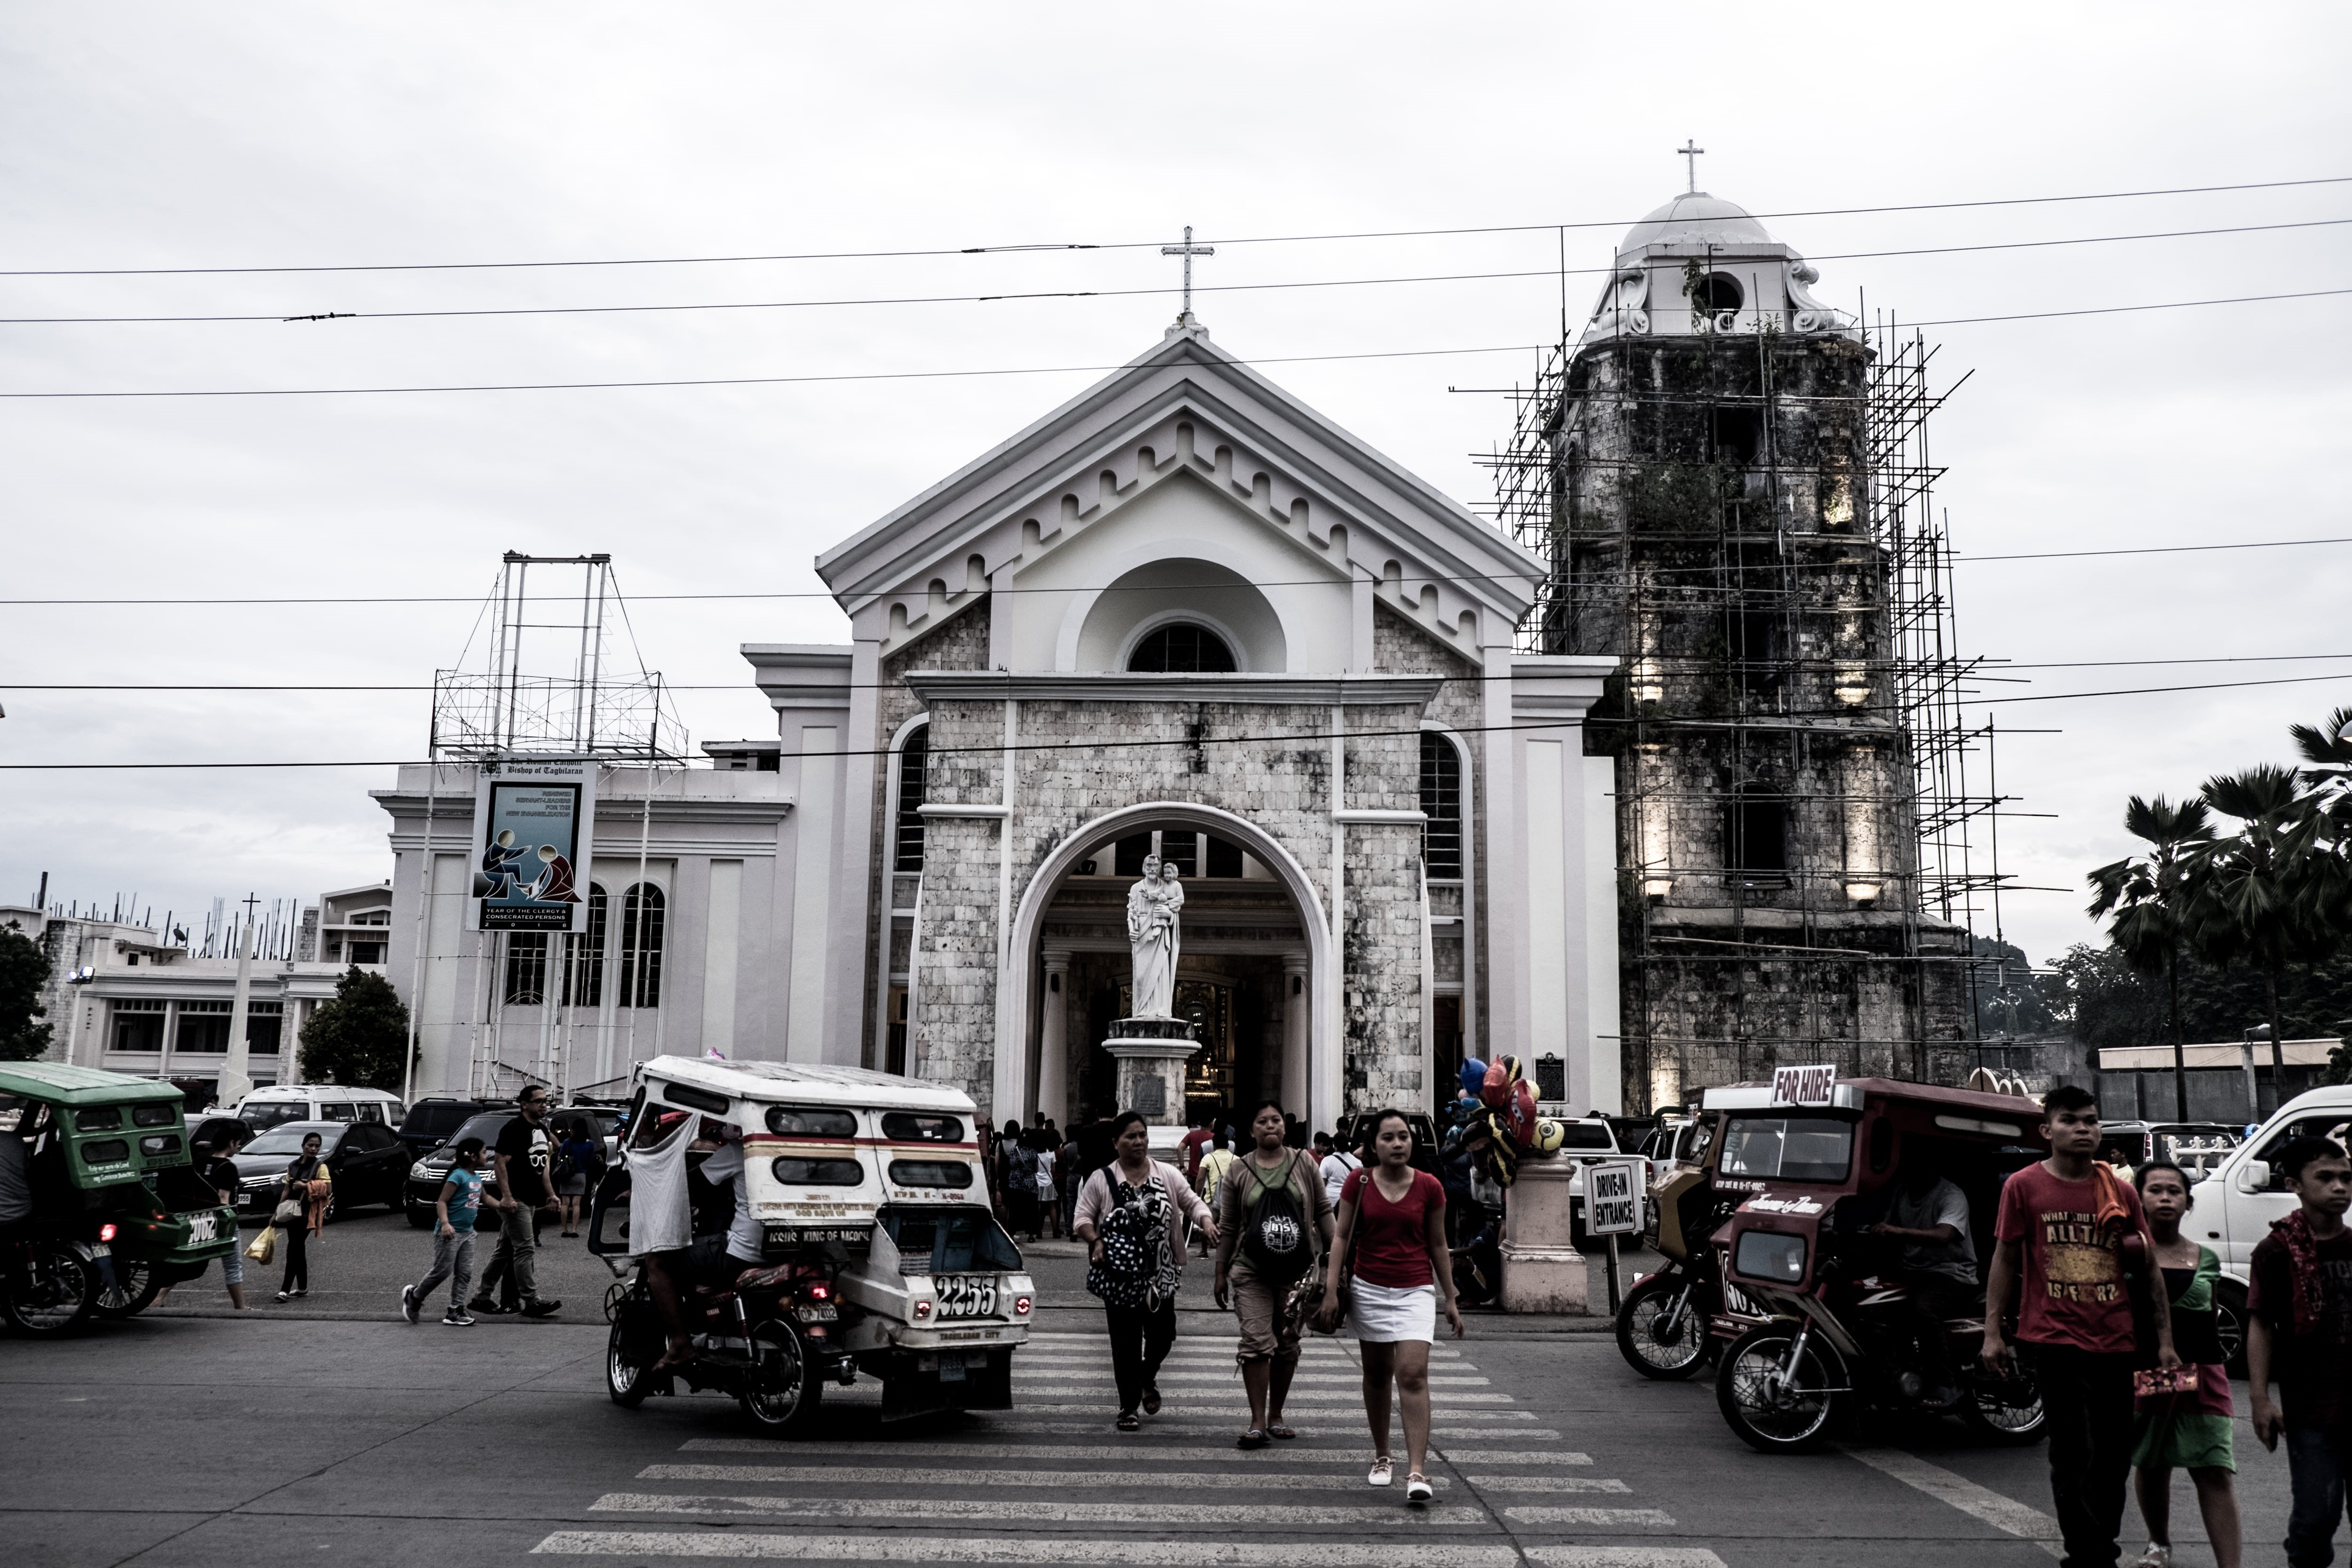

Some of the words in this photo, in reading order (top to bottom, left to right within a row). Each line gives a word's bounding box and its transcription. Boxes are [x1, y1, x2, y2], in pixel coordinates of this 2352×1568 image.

[508, 766, 532, 774] Bishop
[1774, 1070, 1800, 1102] FOR
[1798, 1068, 1833, 1102] HIRE
[1596, 1173, 1628, 1198] DRIVE-IN
[1595, 1200, 1633, 1226] ENTRANCE
[2041, 1212, 2069, 1222] WHAT
[1271, 1223, 1291, 1232] BTS
[2047, 1225, 2078, 1243] ALL
[803, 1231, 825, 1242] KING
[827, 1231, 838, 1242] OF
[937, 1276, 997, 1316] 2255
[2047, 1282, 2062, 1299] IS
